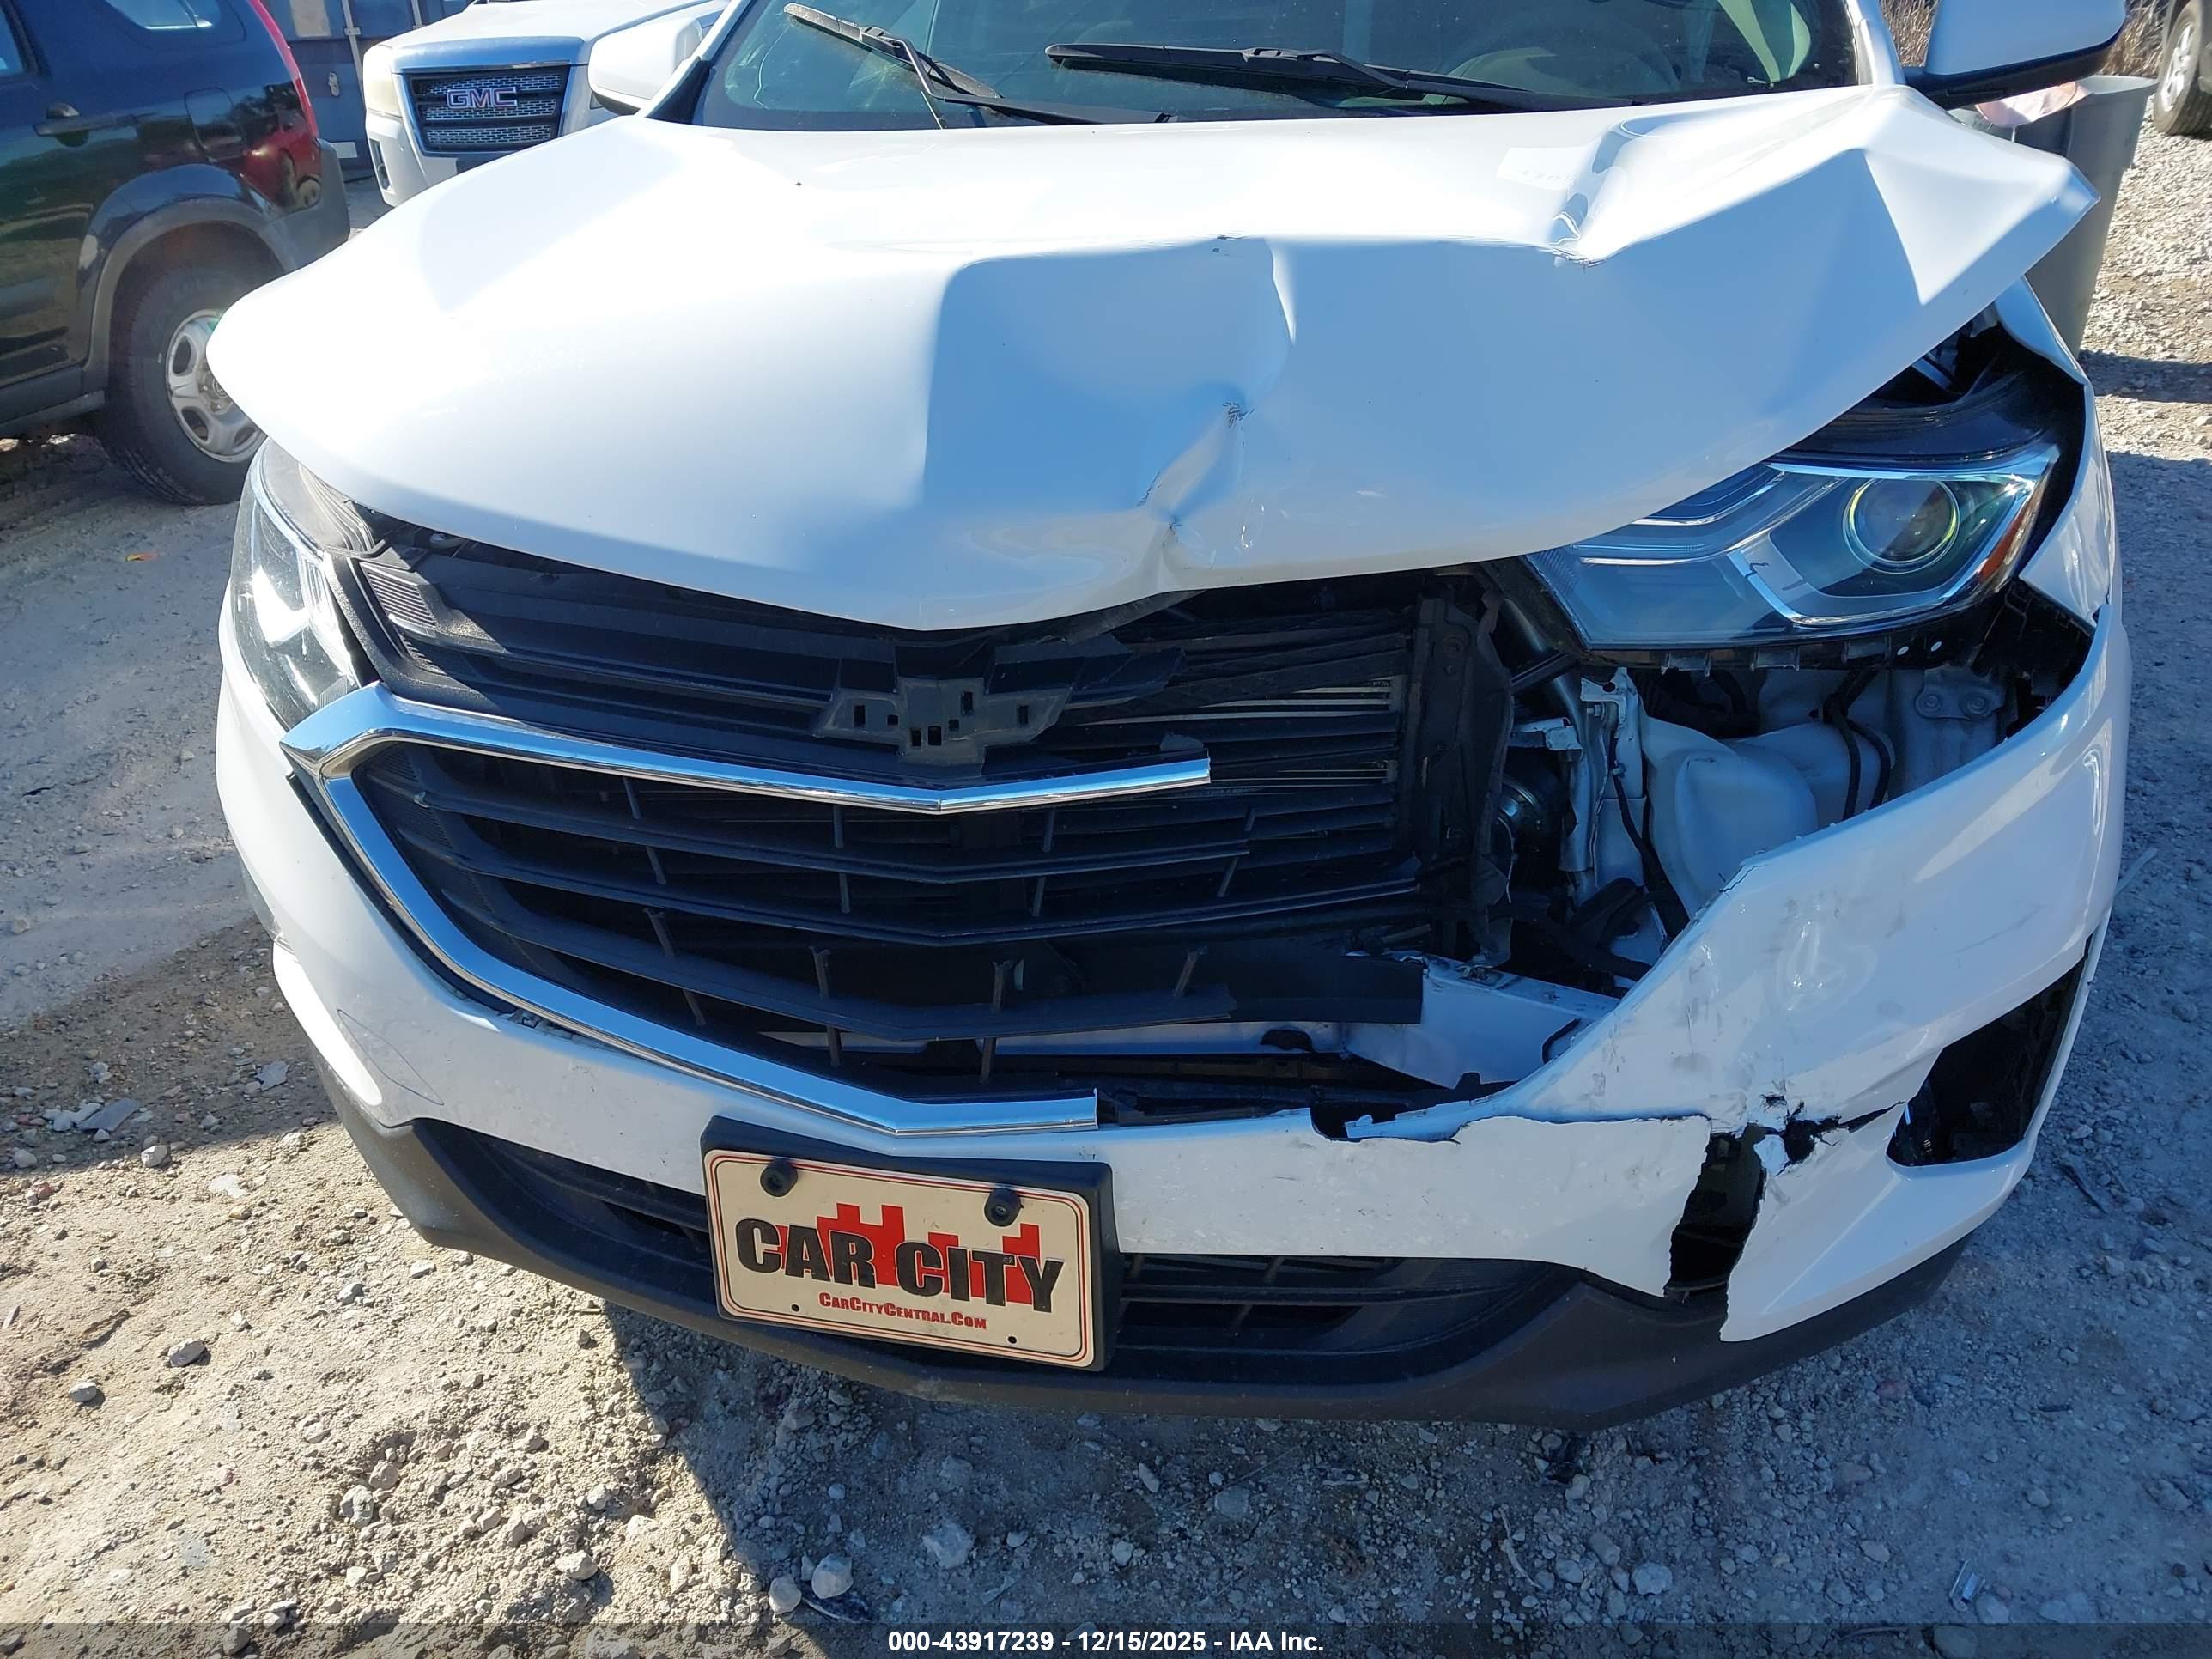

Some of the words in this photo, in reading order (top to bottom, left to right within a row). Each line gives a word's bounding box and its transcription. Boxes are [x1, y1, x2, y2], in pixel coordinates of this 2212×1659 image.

[447, 86, 517, 110] GMC
[735, 1218, 876, 1289] CAR
[896, 1241, 1065, 1313] CITY
